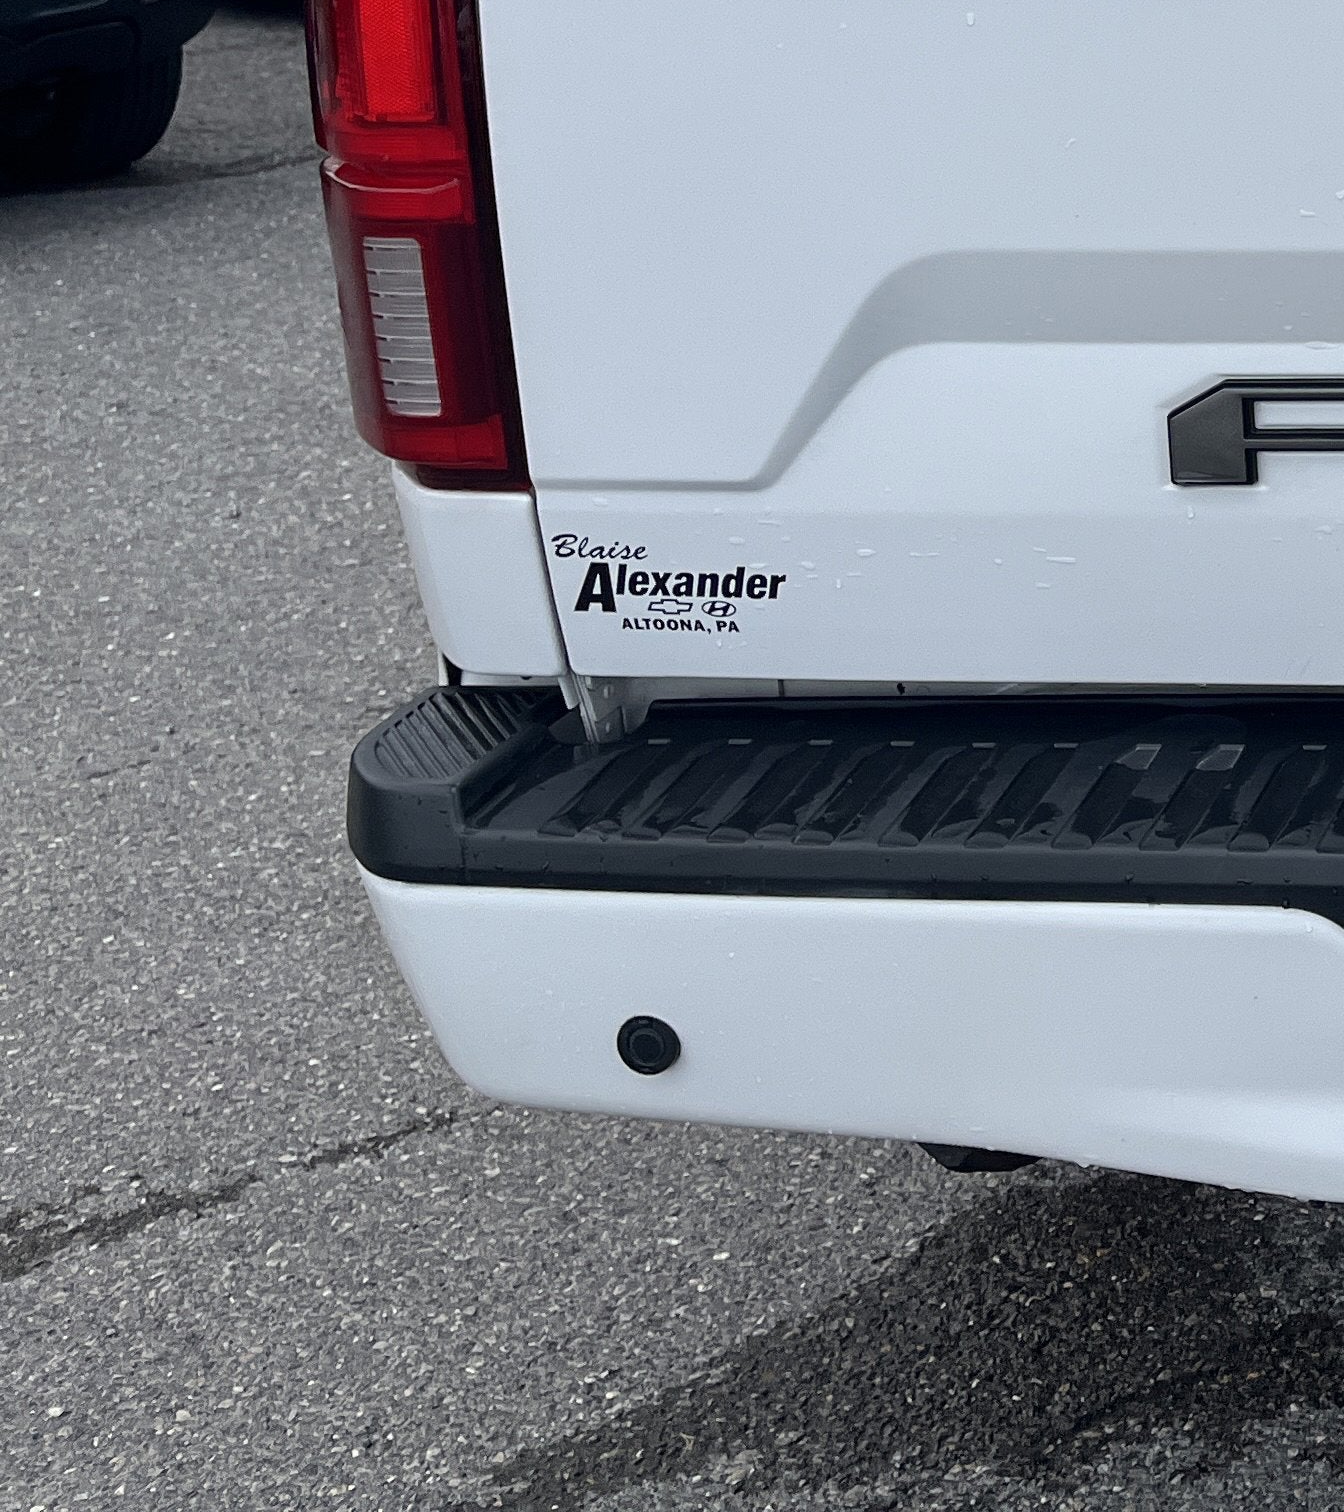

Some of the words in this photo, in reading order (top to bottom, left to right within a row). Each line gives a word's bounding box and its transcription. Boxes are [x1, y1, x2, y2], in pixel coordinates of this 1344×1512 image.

[551, 533, 648, 560] Blaise
[574, 561, 787, 613] Alexander
[622, 617, 712, 635] ALTOONA,
[715, 620, 740, 633] PA
